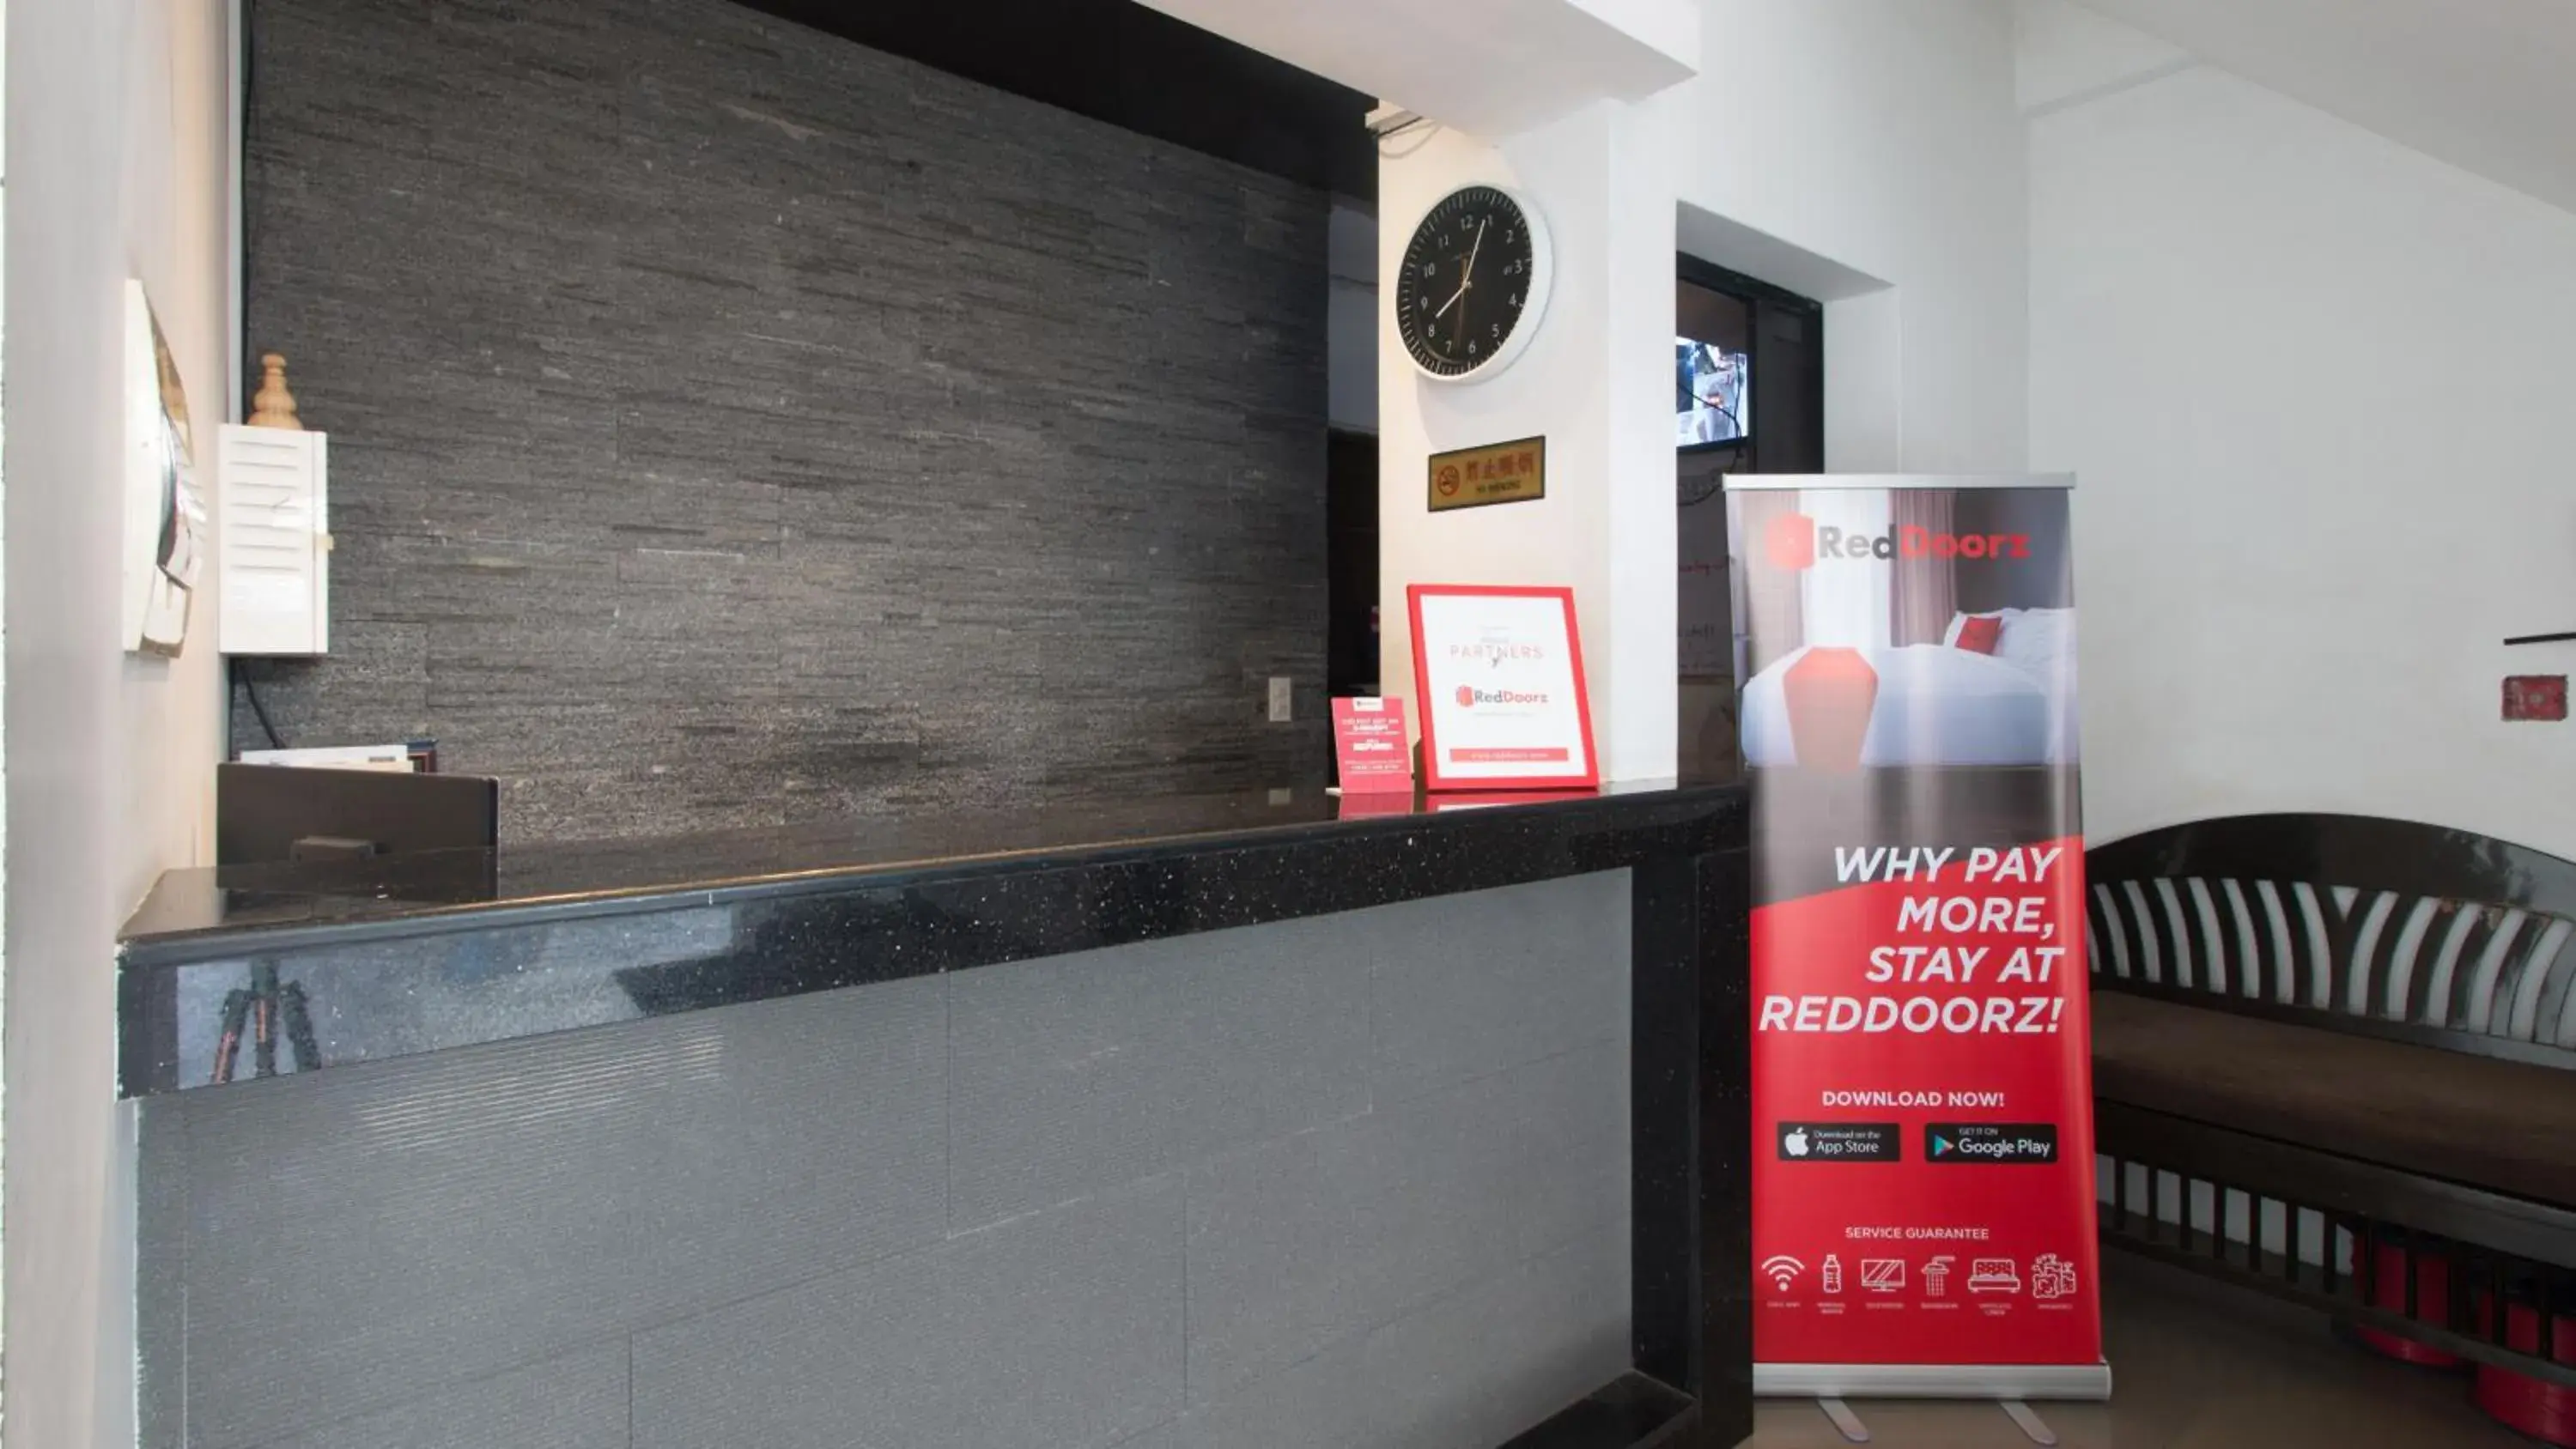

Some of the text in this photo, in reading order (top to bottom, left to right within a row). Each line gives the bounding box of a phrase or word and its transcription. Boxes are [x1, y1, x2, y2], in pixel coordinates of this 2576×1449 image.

[1460, 215, 1474, 230] 12
[1437, 234, 1449, 249] 11
[1505, 230, 1515, 243] 2
[1423, 263, 1435, 278] 10
[1514, 260, 1522, 274] 3
[1509, 294, 1516, 306] 4
[1428, 324, 1435, 337] 8
[1492, 324, 1499, 337] 5
[1445, 340, 1452, 353] 7
[1468, 340, 1476, 354] 6
[1818, 523, 2032, 560] RedDoorz
[1449, 644, 1545, 660] PARTNERS
[1474, 689, 1549, 704] RedDoorz
[1834, 846, 2064, 882] WHY PAY
[1897, 897, 2055, 939] MORE,
[1865, 947, 2066, 983] STAY AT
[1759, 996, 2065, 1034] REDDOORZ!
[1821, 1091, 2006, 1107] DOWNLOAD NOW!
[1814, 1130, 1854, 1139] Download
[1816, 1139, 1880, 1154] App Store
[1959, 1137, 2051, 1159] Google Play
[1845, 1226, 1990, 1240] SERVICE GUARANTEE
